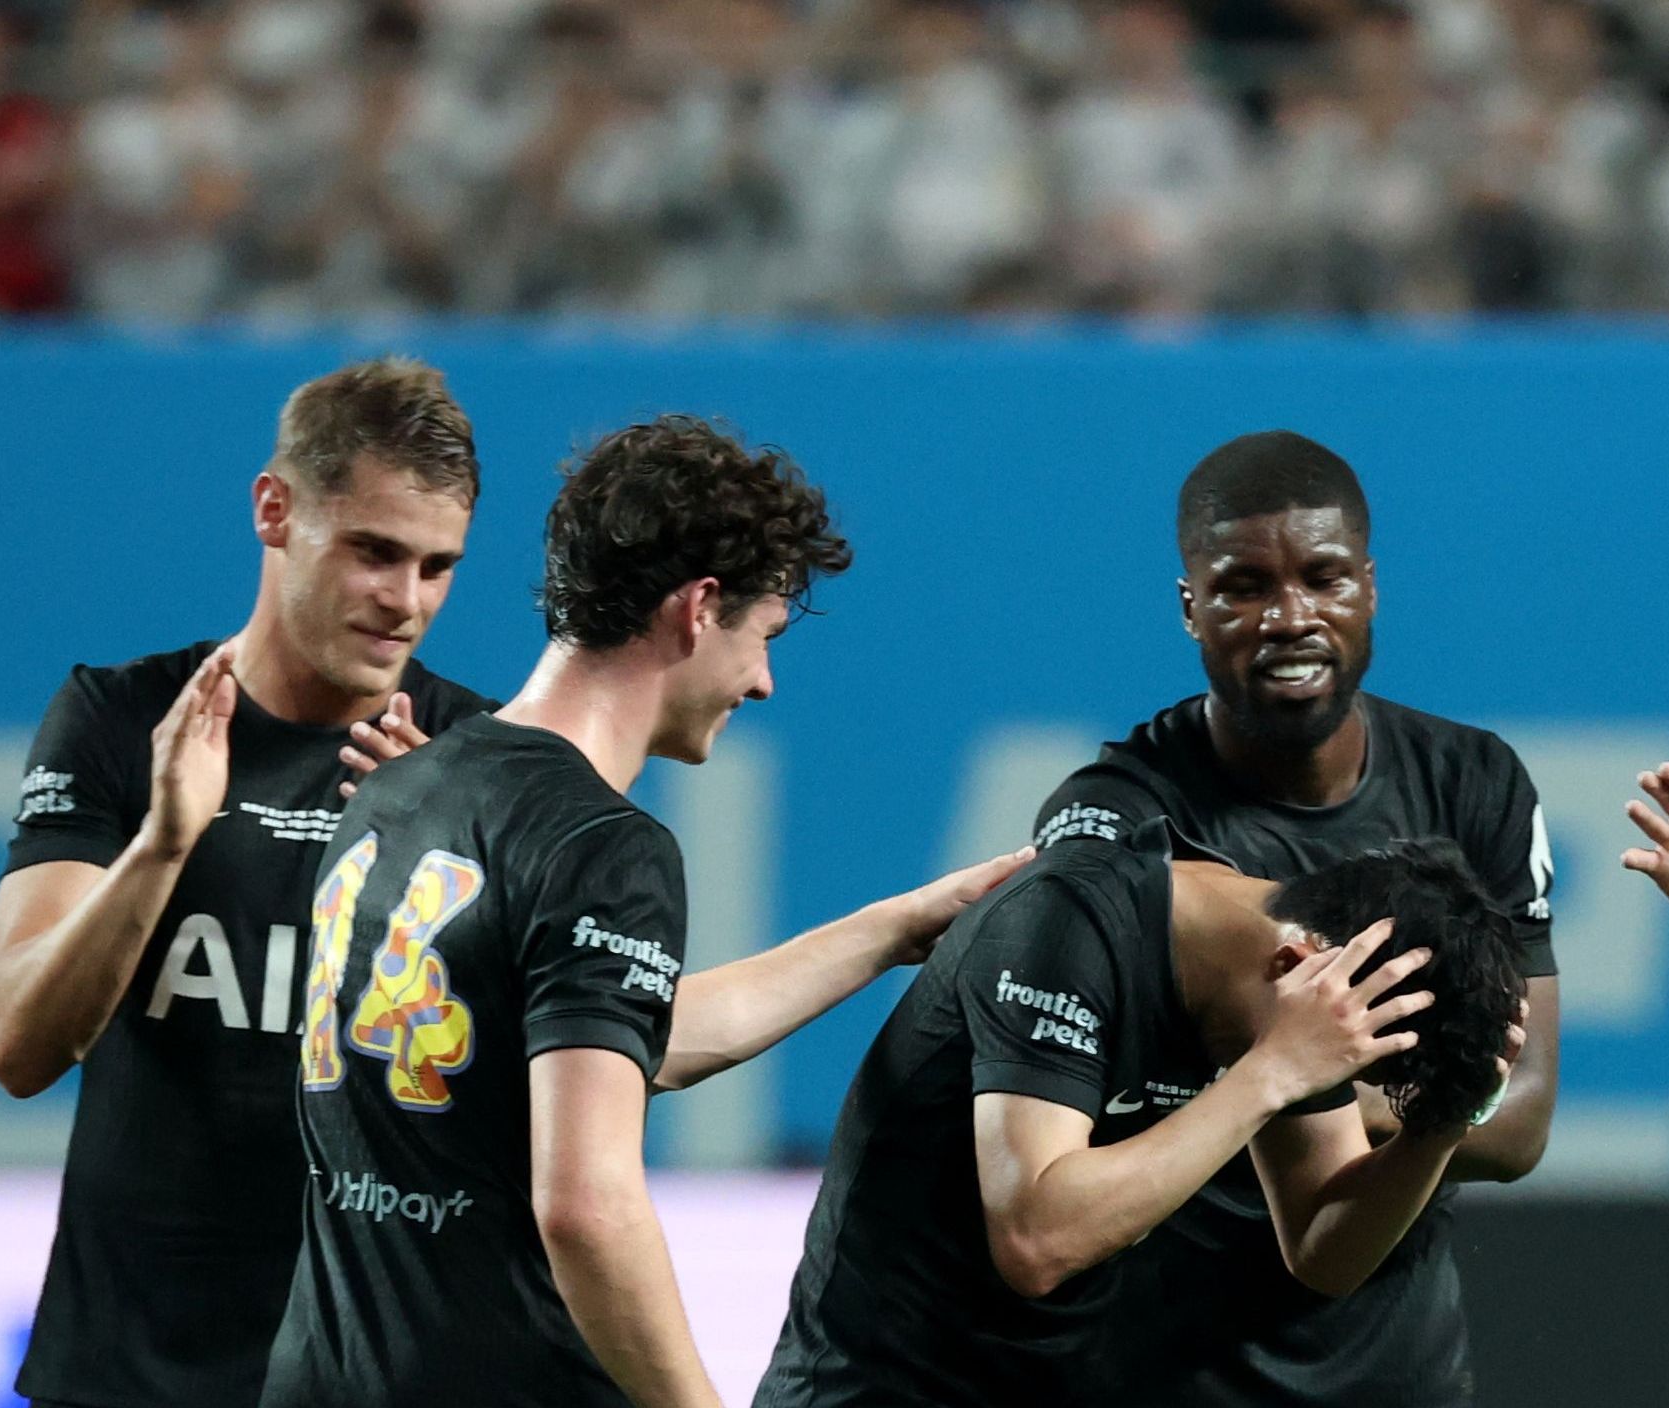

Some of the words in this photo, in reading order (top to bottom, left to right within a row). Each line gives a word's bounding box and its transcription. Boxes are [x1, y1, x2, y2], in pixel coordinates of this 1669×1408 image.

[146, 913, 304, 1035] AI
[303, 830, 486, 1113] 14
[572, 916, 681, 977] frontier
[621, 964, 674, 1003] pets
[996, 970, 1101, 1033] frontier
[1031, 1017, 1098, 1055] pets
